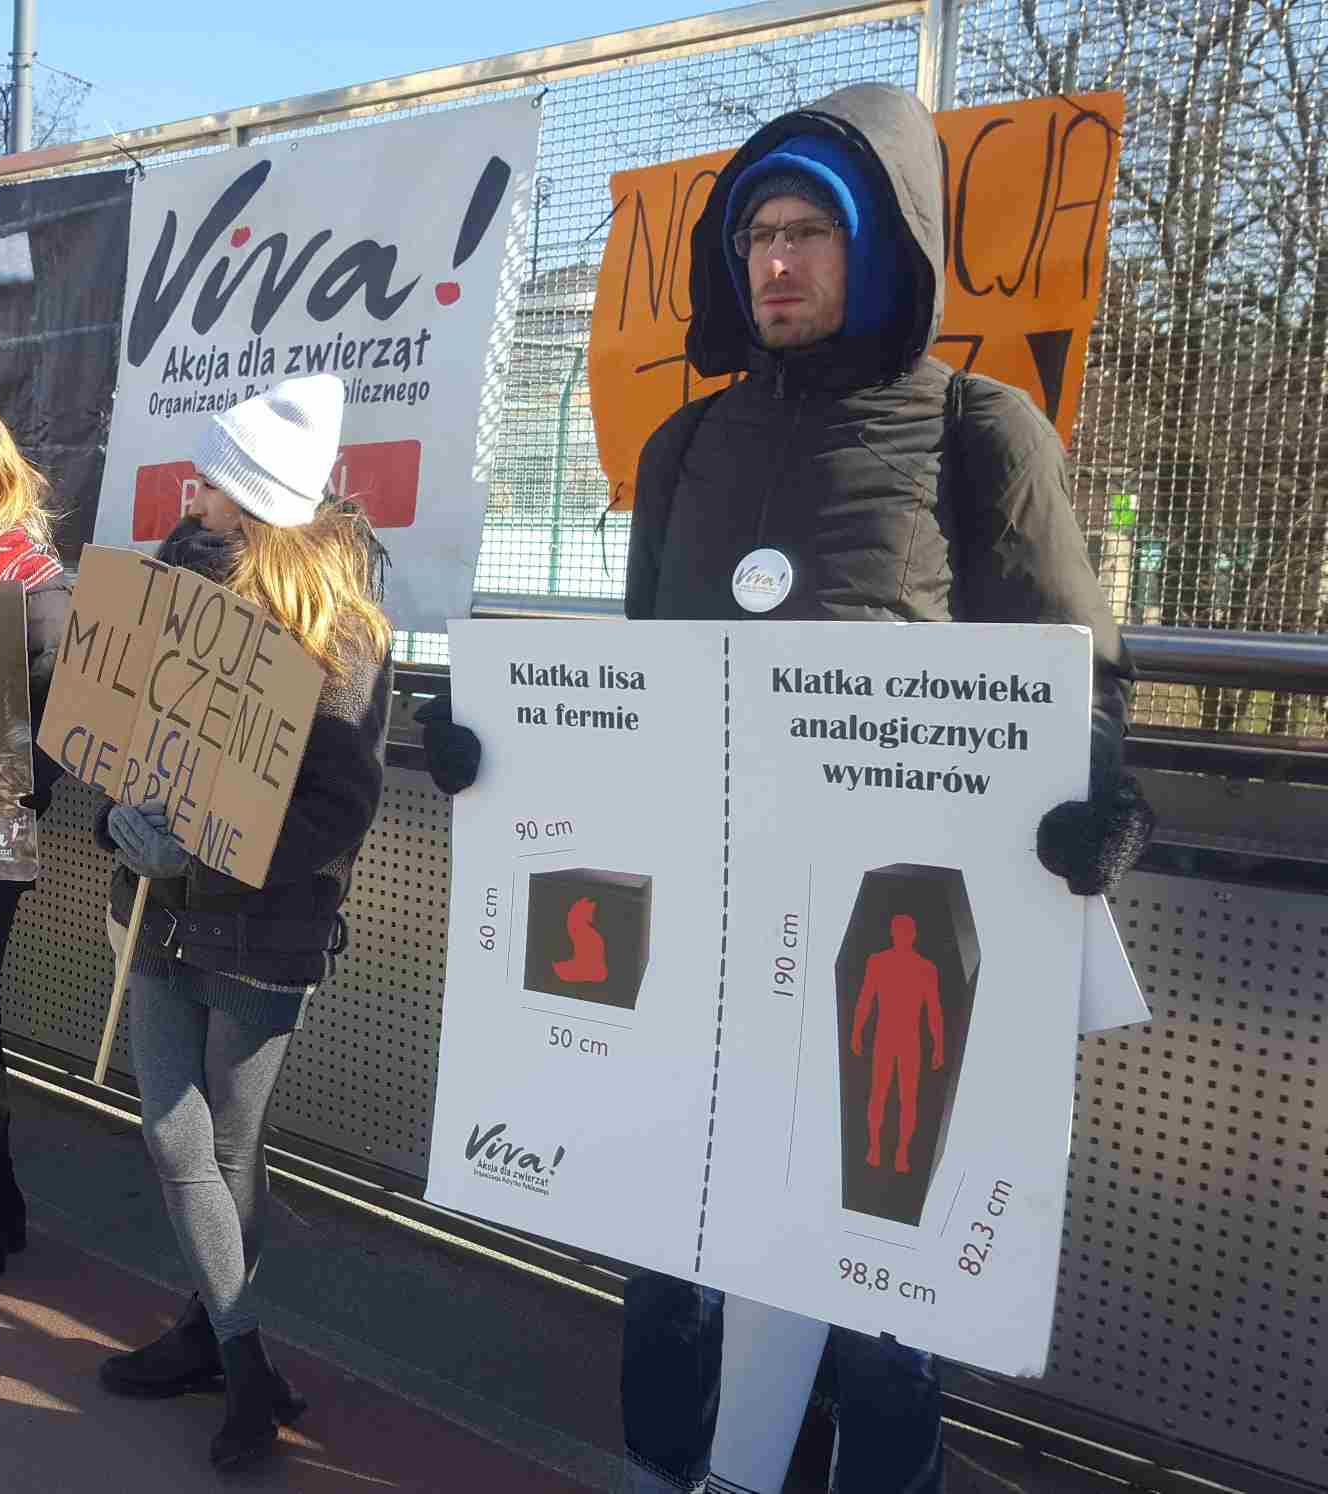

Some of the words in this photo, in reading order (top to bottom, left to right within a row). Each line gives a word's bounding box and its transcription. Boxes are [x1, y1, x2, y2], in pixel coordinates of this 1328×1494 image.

[127, 155, 512, 368] Viva!
[162, 344, 229, 386] Akcja
[238, 337, 275, 378] dla
[284, 329, 432, 375] zwierząt
[148, 387, 238, 419] Organizacja
[138, 558, 281, 695] TWOJE
[509, 662, 590, 689] Klatka
[599, 664, 647, 691] lisa
[771, 666, 874, 697] Klatka
[885, 669, 1054, 704] człowieka
[62, 609, 297, 789] MILCZENIE
[516, 705, 548, 726] na
[555, 702, 640, 731] fermie
[789, 713, 1029, 755] analogicznych
[144, 718, 201, 796] ICH
[821, 761, 992, 796] wymiarów
[515, 820, 539, 841] 90
[544, 819, 574, 838] cm
[485, 887, 498, 918] cm
[479, 925, 497, 951] 60
[783, 913, 799, 948] cm
[772, 956, 797, 997] 190
[548, 1026, 573, 1049] 50
[579, 1037, 609, 1057] cm
[465, 1123, 566, 1176] Viva!
[957, 1220, 995, 1277] 82,3
[986, 1178, 1014, 1217] cm
[838, 1256, 891, 1292] 98,8
[898, 1280, 937, 1305] cm
